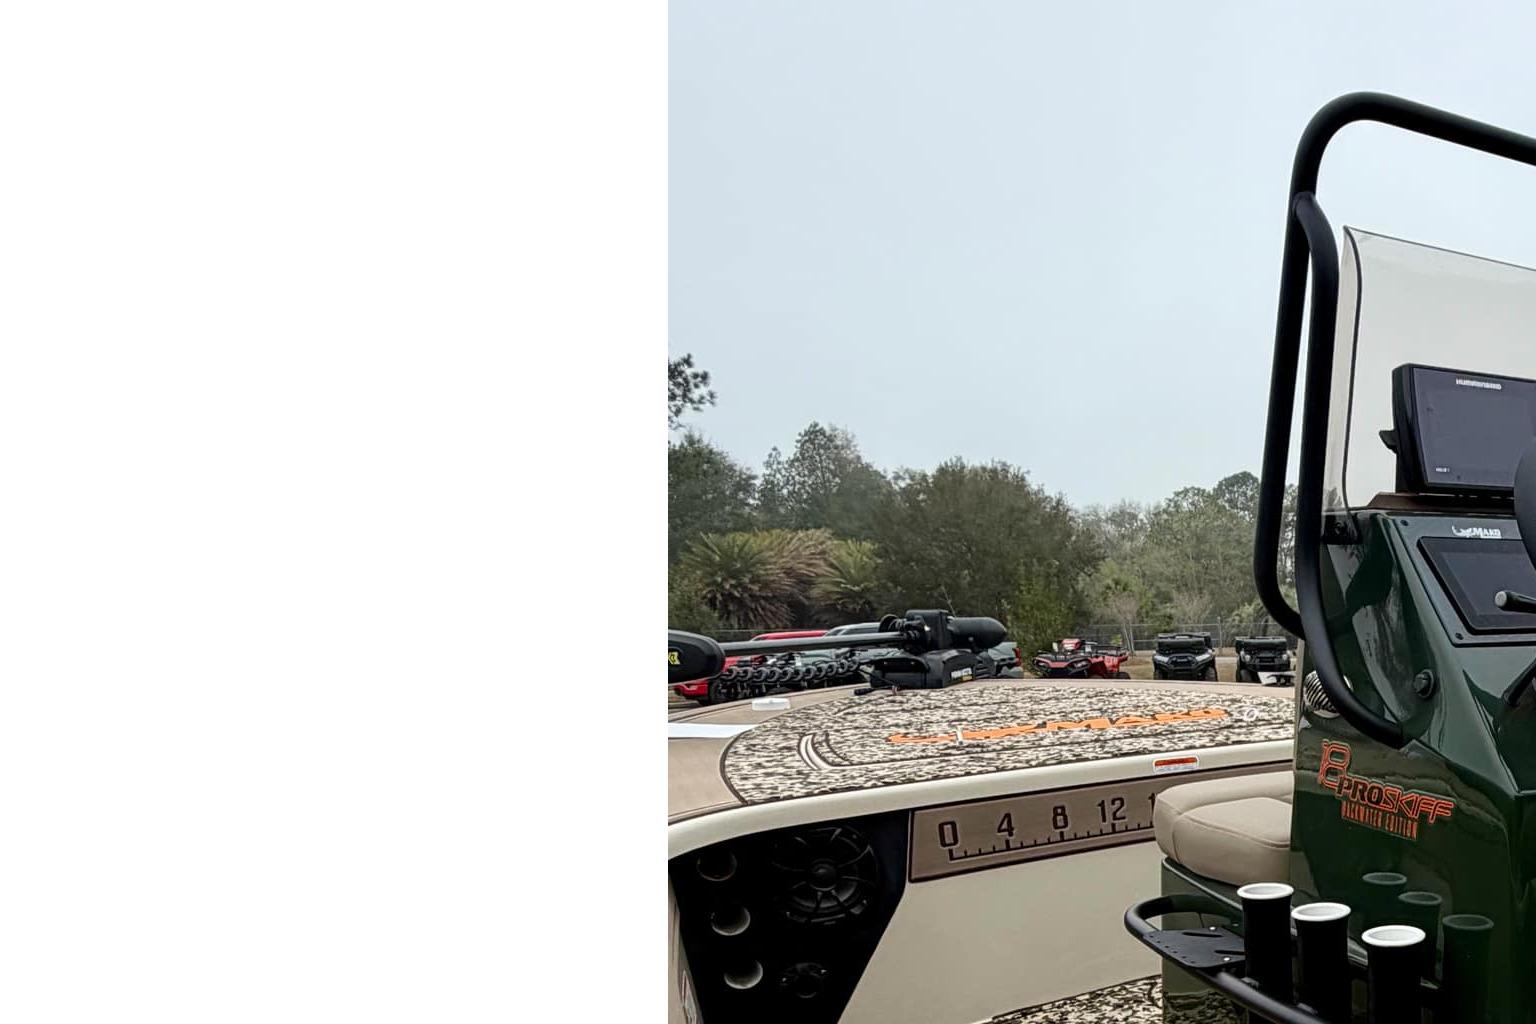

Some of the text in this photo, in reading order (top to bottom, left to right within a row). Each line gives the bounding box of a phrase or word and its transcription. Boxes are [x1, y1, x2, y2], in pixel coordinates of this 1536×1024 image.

[938, 821, 959, 848] 0
[997, 813, 1014, 837] 4
[1052, 805, 1069, 830] 8
[1097, 797, 1126, 823] 12
